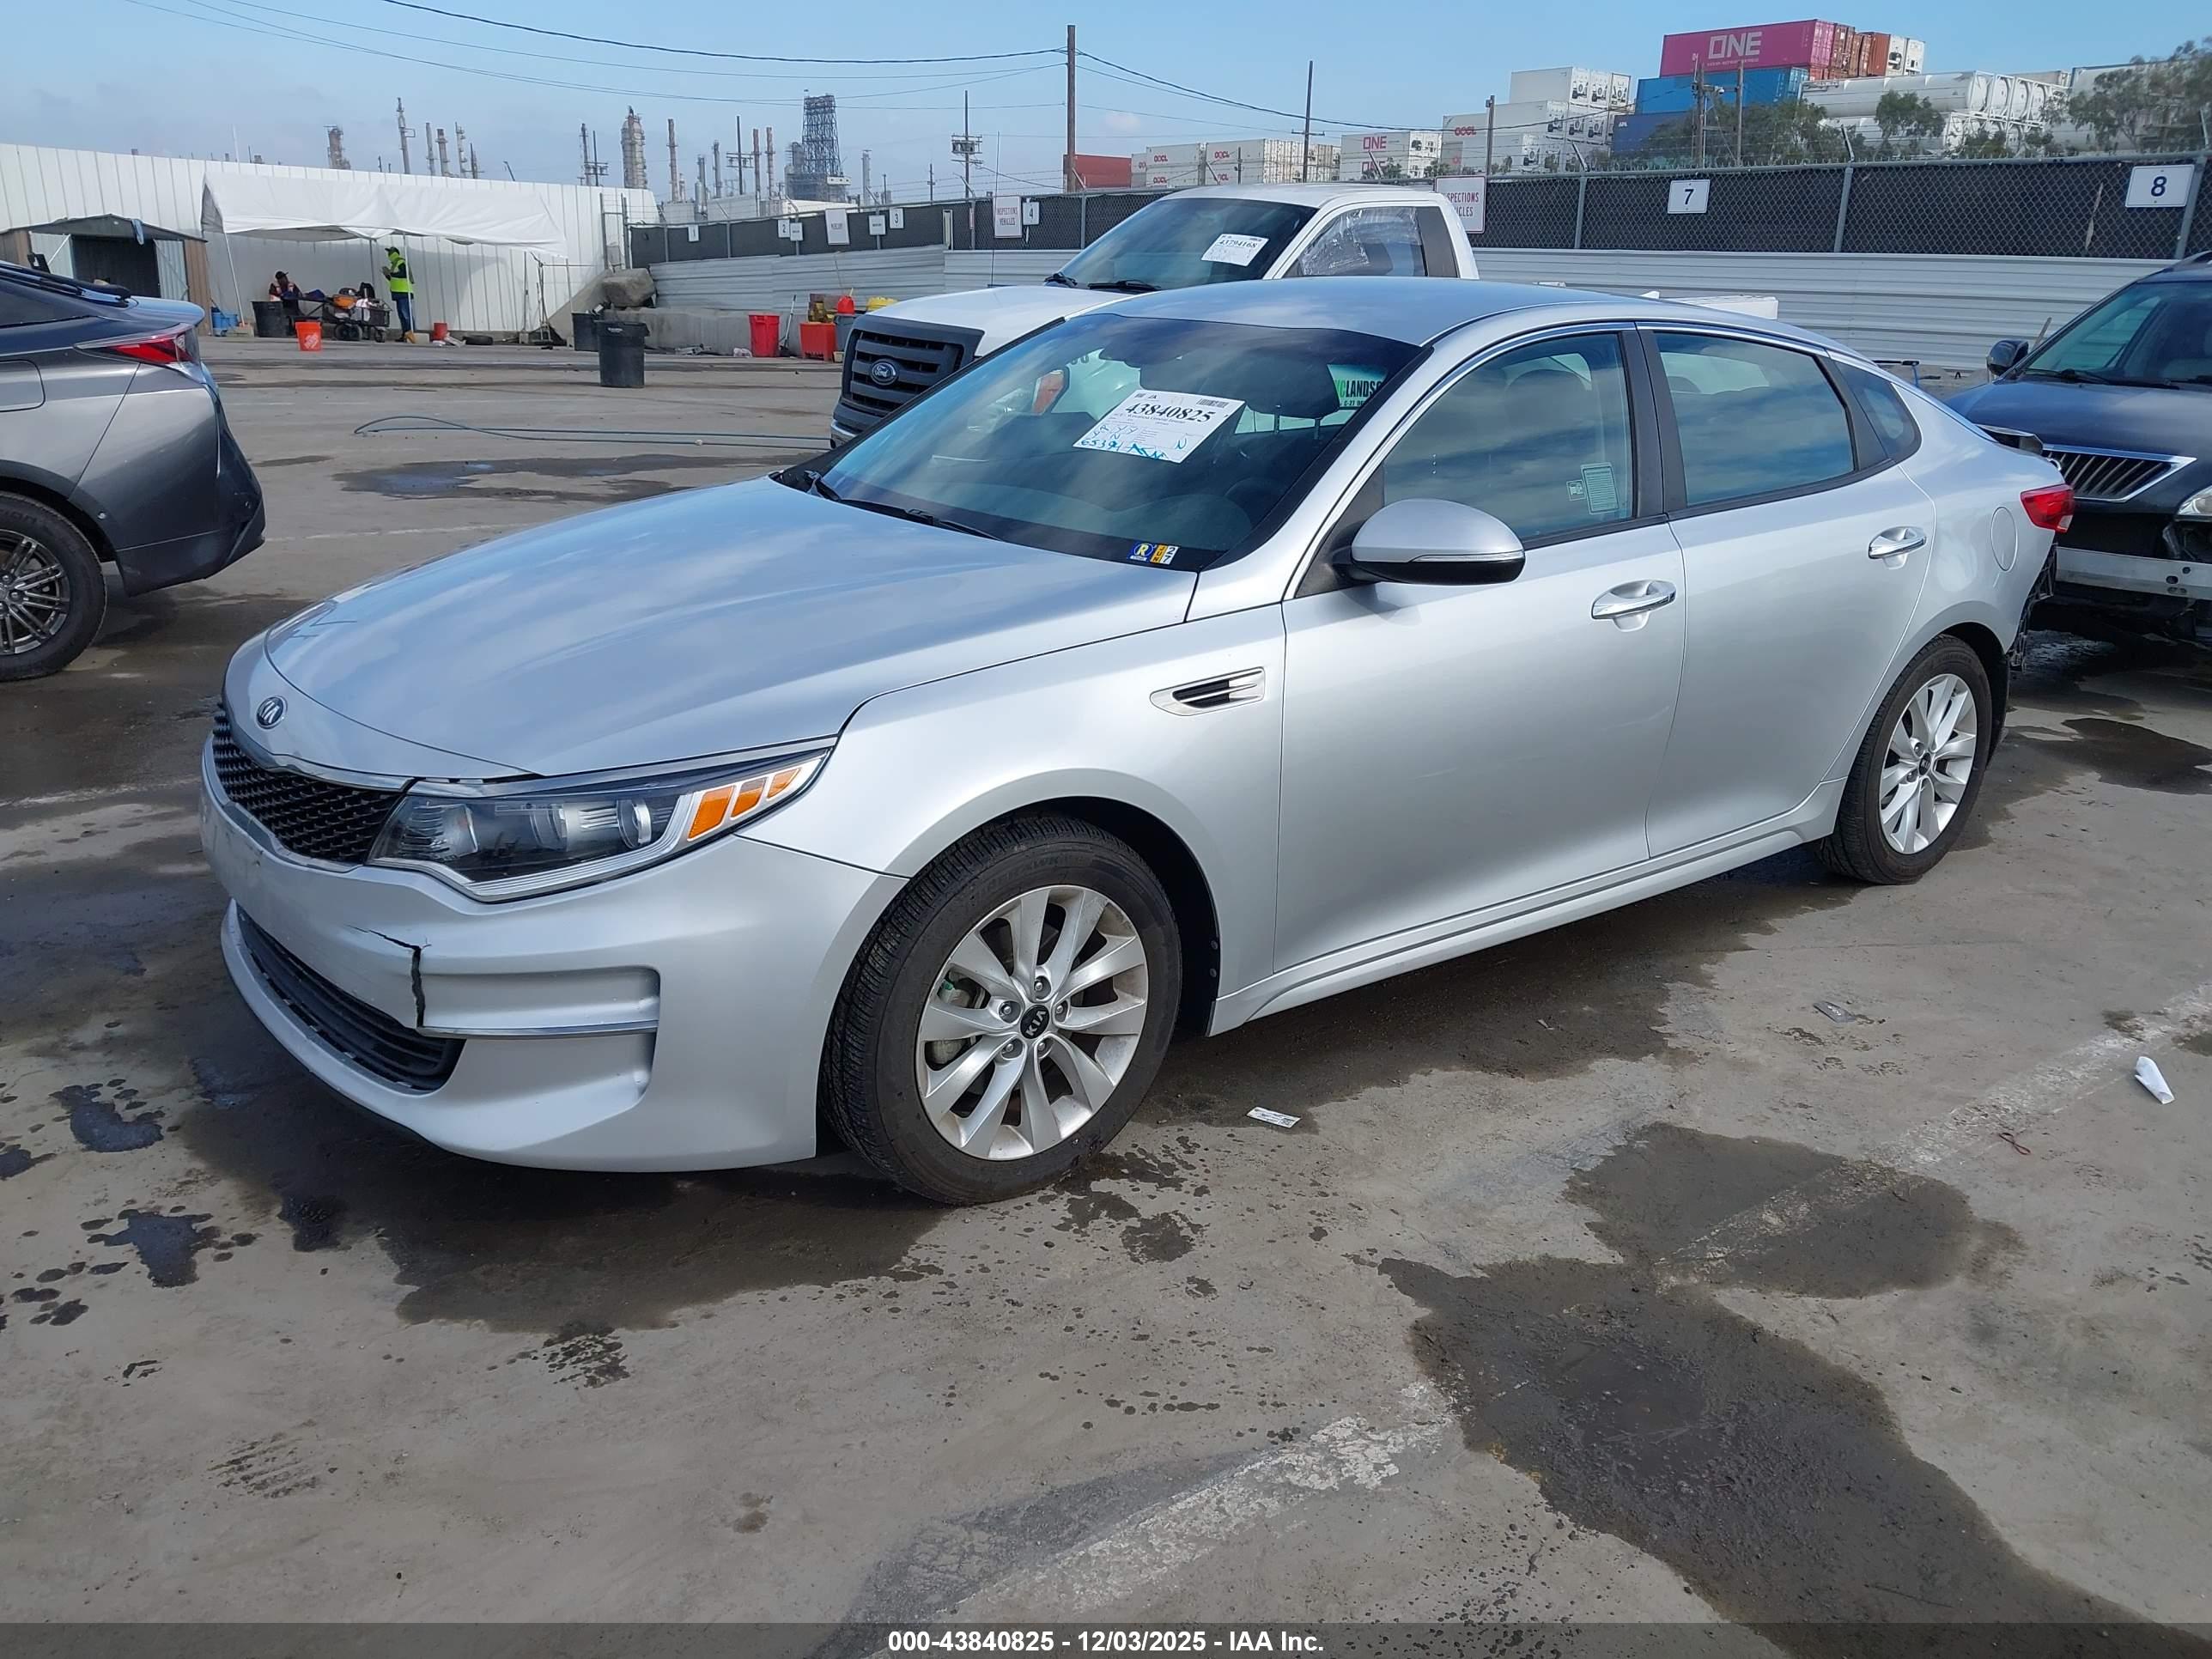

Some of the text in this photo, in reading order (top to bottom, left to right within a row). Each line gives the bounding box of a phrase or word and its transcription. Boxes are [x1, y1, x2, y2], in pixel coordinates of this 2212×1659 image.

[1708, 32, 1762, 59] ONE
[1454, 125, 1477, 137] OOCL
[1362, 136, 1387, 150] ONE
[1214, 150, 1231, 160] OOCL
[2150, 175, 2167, 197] 8
[1447, 191, 1480, 203] SPECTIONS
[1684, 189, 1695, 205] 7
[894, 213, 899, 223] 3
[1030, 208, 1033, 219] 4
[1456, 206, 1474, 217] ICLES
[782, 224, 787, 234] 2
[1125, 403, 1215, 422] 43840825
[1163, 546, 1176, 563] 27
[1025, 1011, 1047, 1036] KIA
